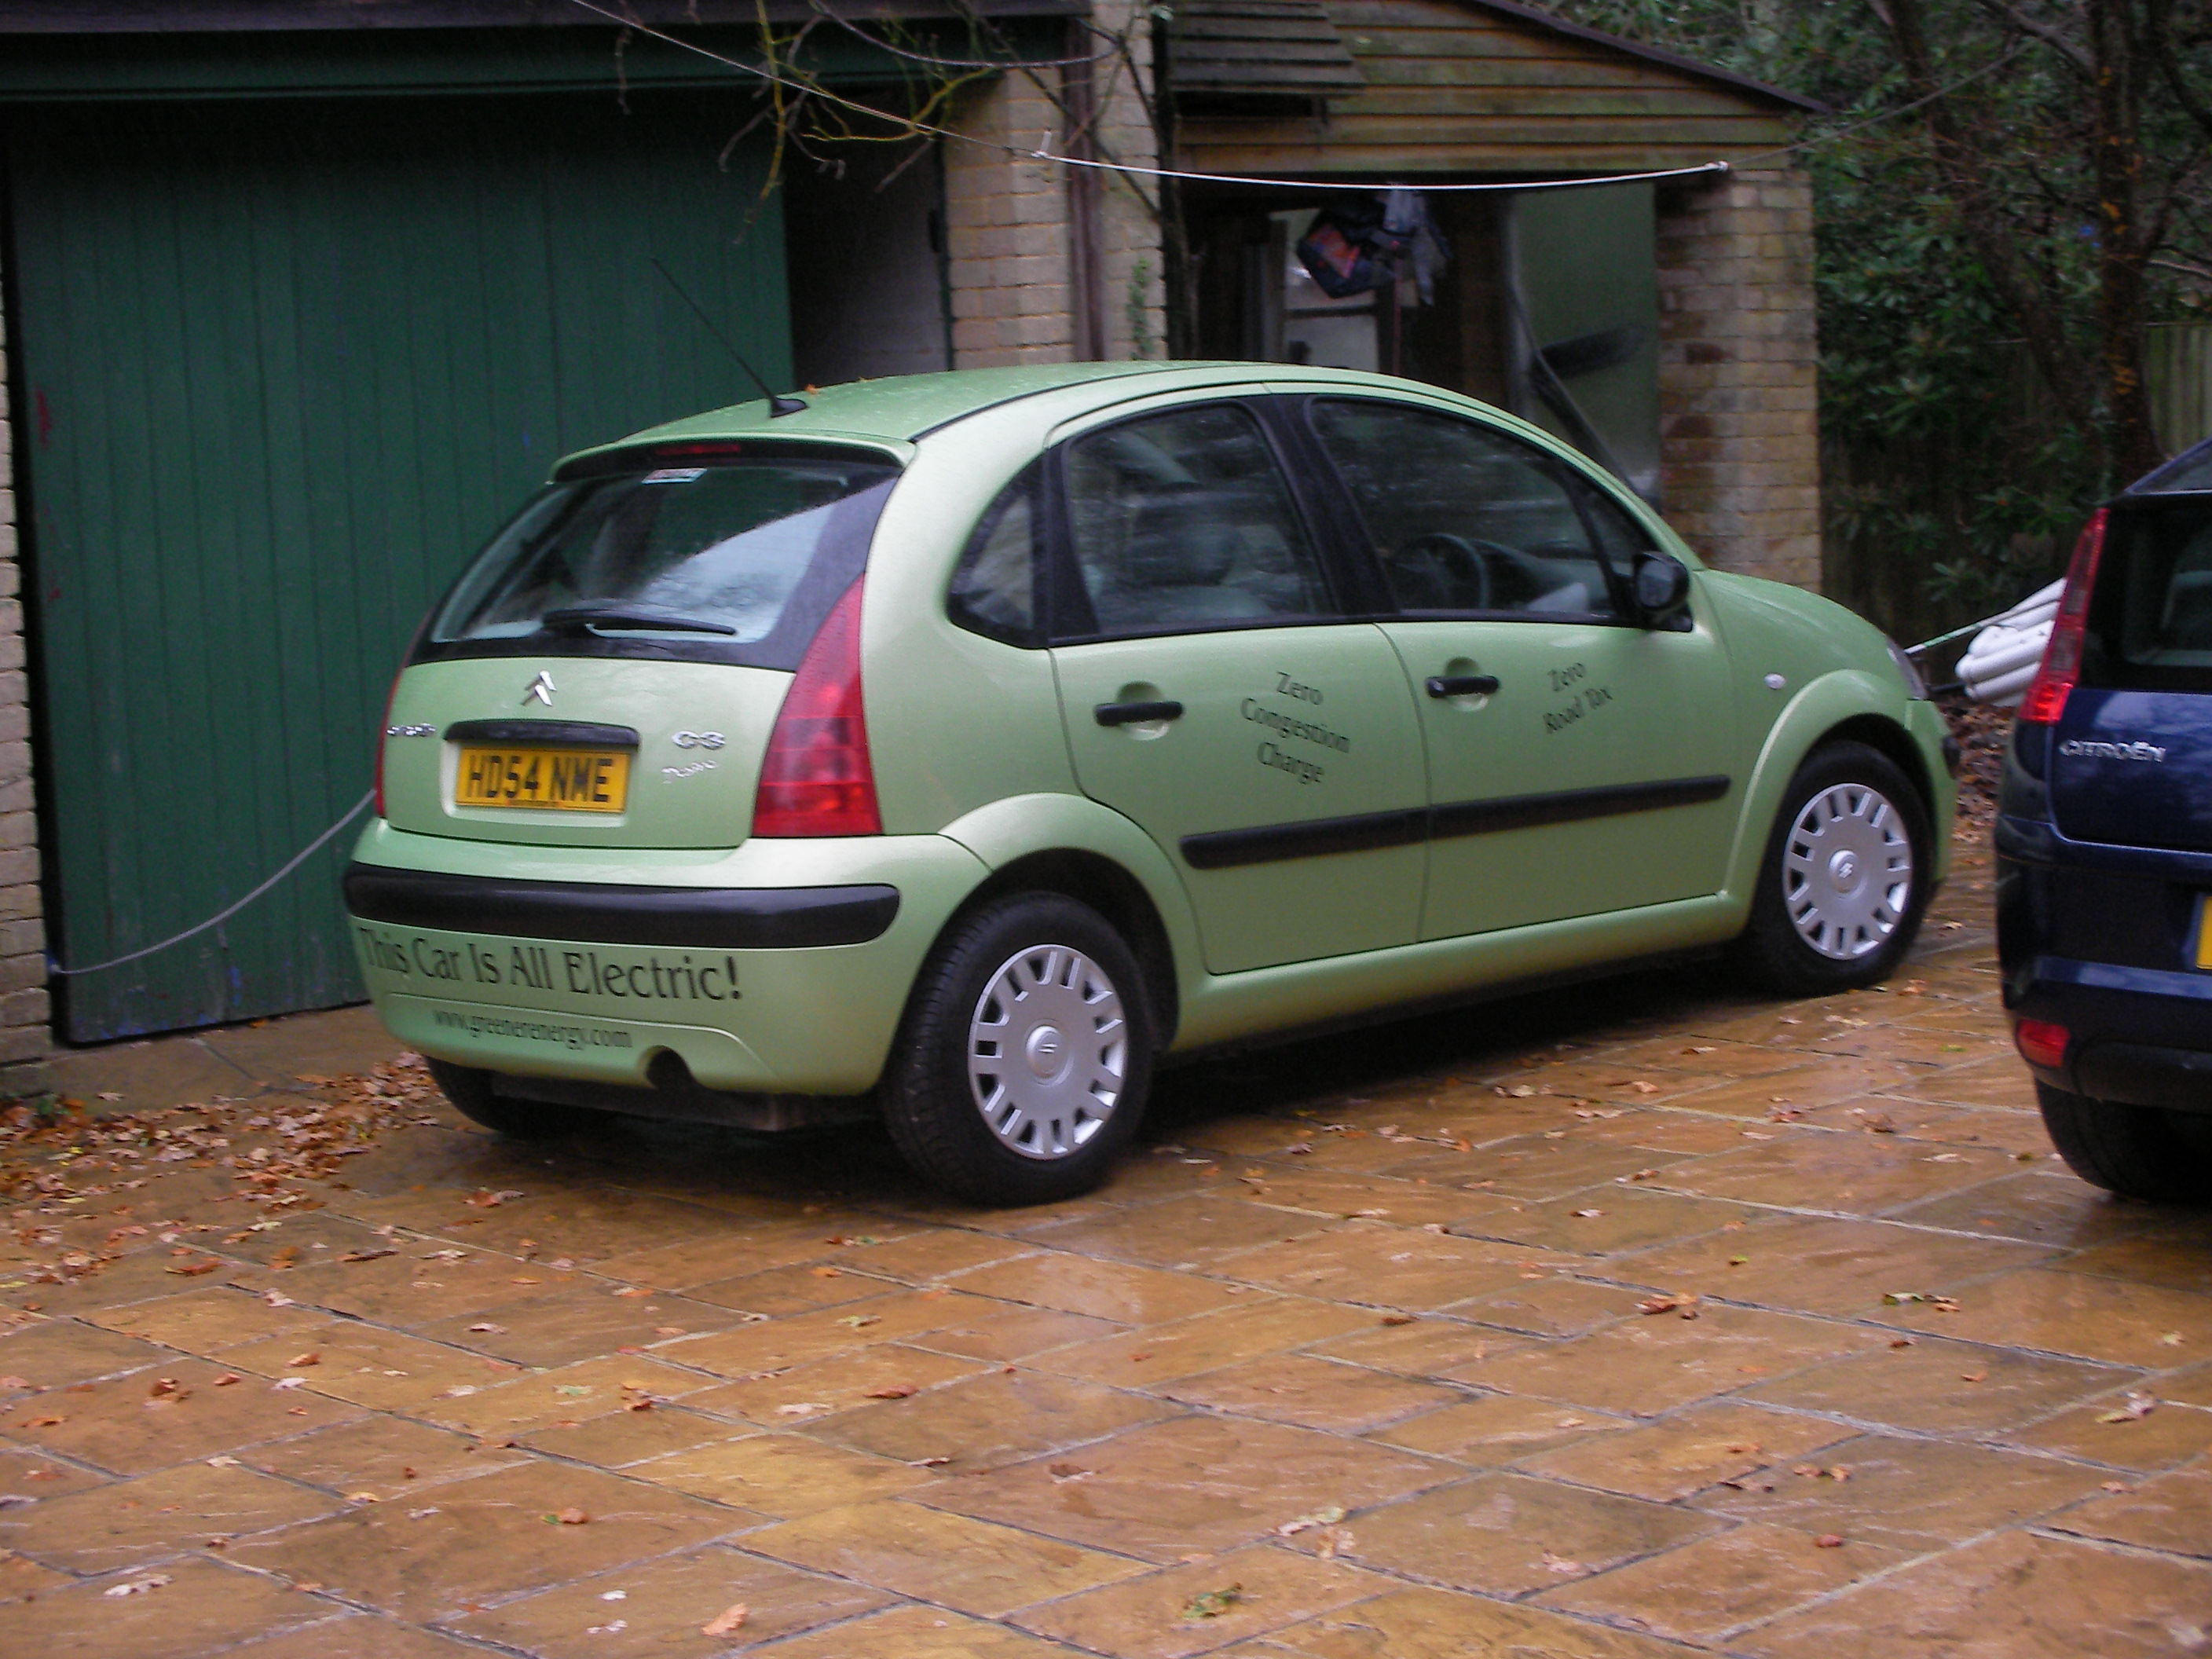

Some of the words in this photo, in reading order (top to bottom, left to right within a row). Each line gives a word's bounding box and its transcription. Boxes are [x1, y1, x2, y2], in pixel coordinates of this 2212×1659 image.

[1277, 672, 1324, 705] Zero
[1547, 663, 1587, 692] Zero
[1241, 698, 1350, 753] Congestion
[1544, 698, 1582, 734] Road
[672, 731, 726, 751] C3
[469, 755, 540, 800] HD54
[551, 758, 612, 803] NME
[1258, 742, 1325, 785] Charge
[359, 928, 410, 973] This
[413, 938, 460, 980] Car
[468, 944, 500, 983] Is
[510, 947, 554, 990] All
[563, 953, 742, 1001] Electric!
